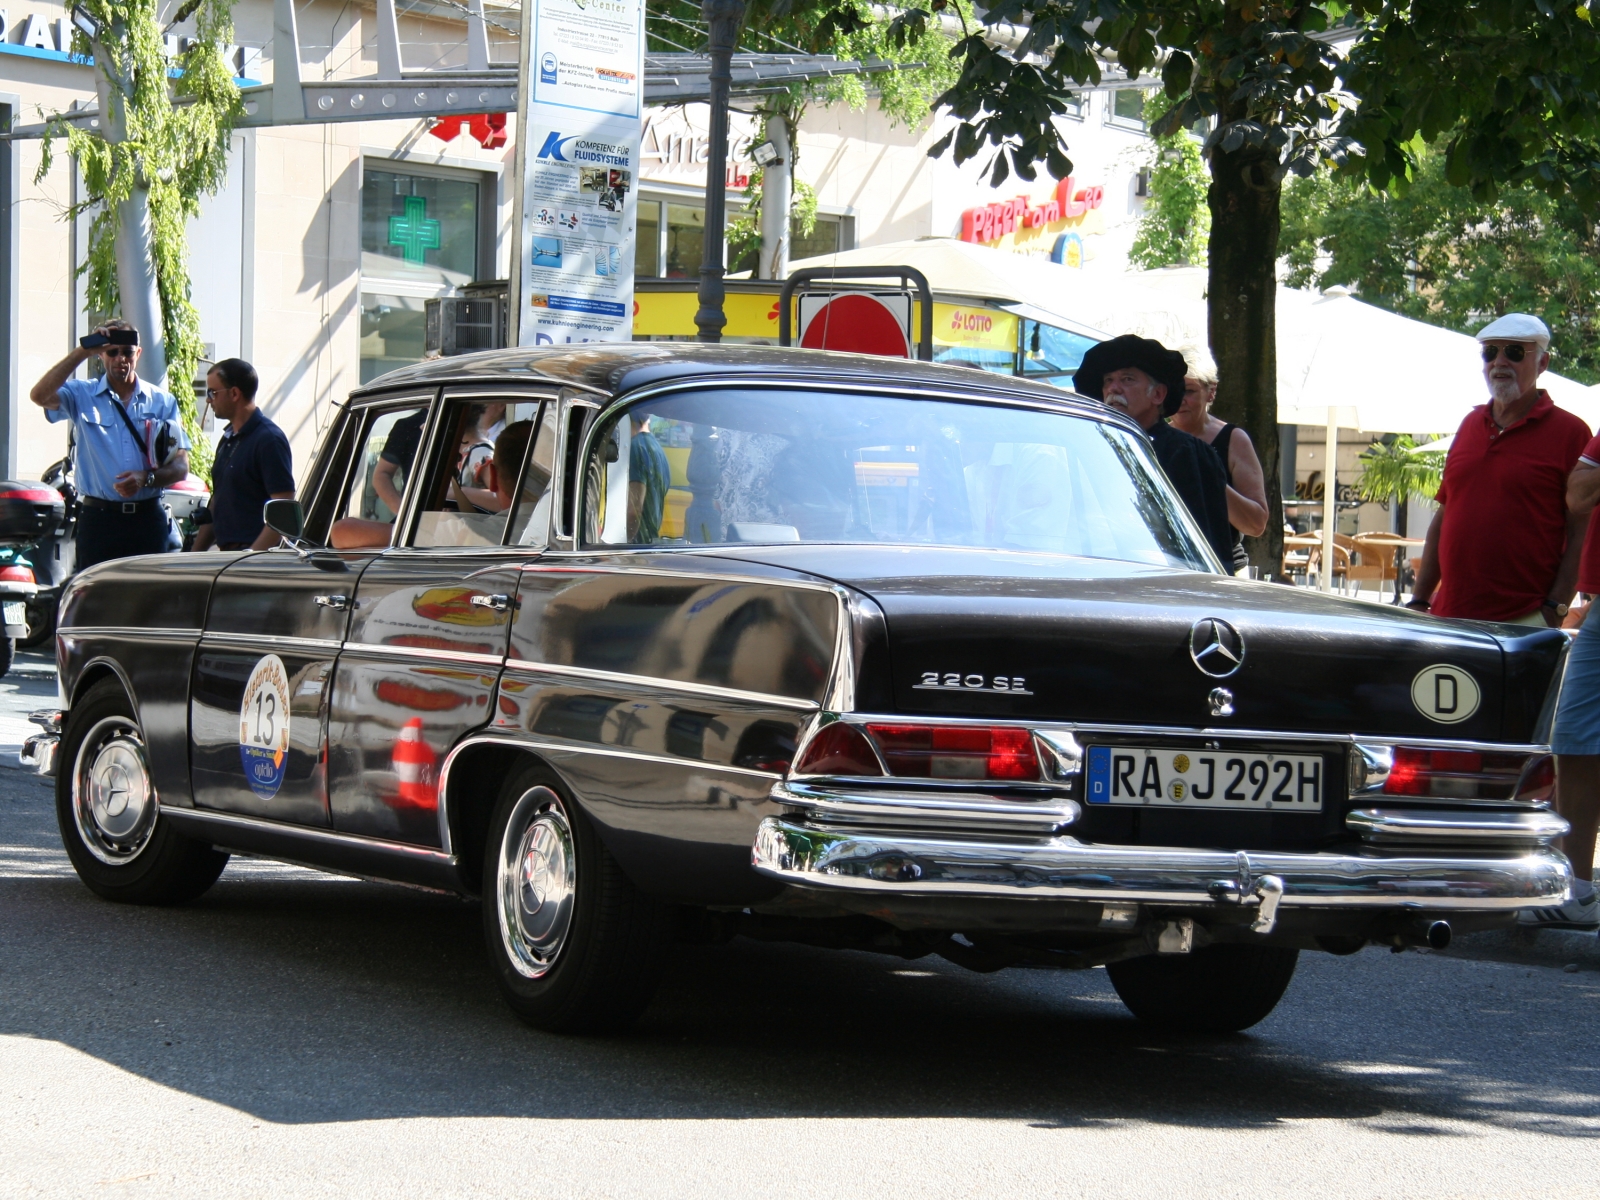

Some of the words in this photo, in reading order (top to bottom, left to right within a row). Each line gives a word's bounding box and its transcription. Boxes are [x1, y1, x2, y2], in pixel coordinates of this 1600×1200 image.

[575, 140, 616, 154] KOMPETENZ
[616, 145, 630, 156] FÜR
[574, 150, 629, 167] FLUIDSYSTEME
[1028, 200, 1060, 228] am
[1057, 176, 1104, 218] Leo
[963, 313, 993, 333] LOTTO
[920, 671, 985, 688] 220
[992, 676, 1026, 691] SE
[1434, 673, 1458, 715] D
[253, 690, 276, 746] 13
[1112, 754, 1163, 798] RA
[1094, 781, 1103, 794] D
